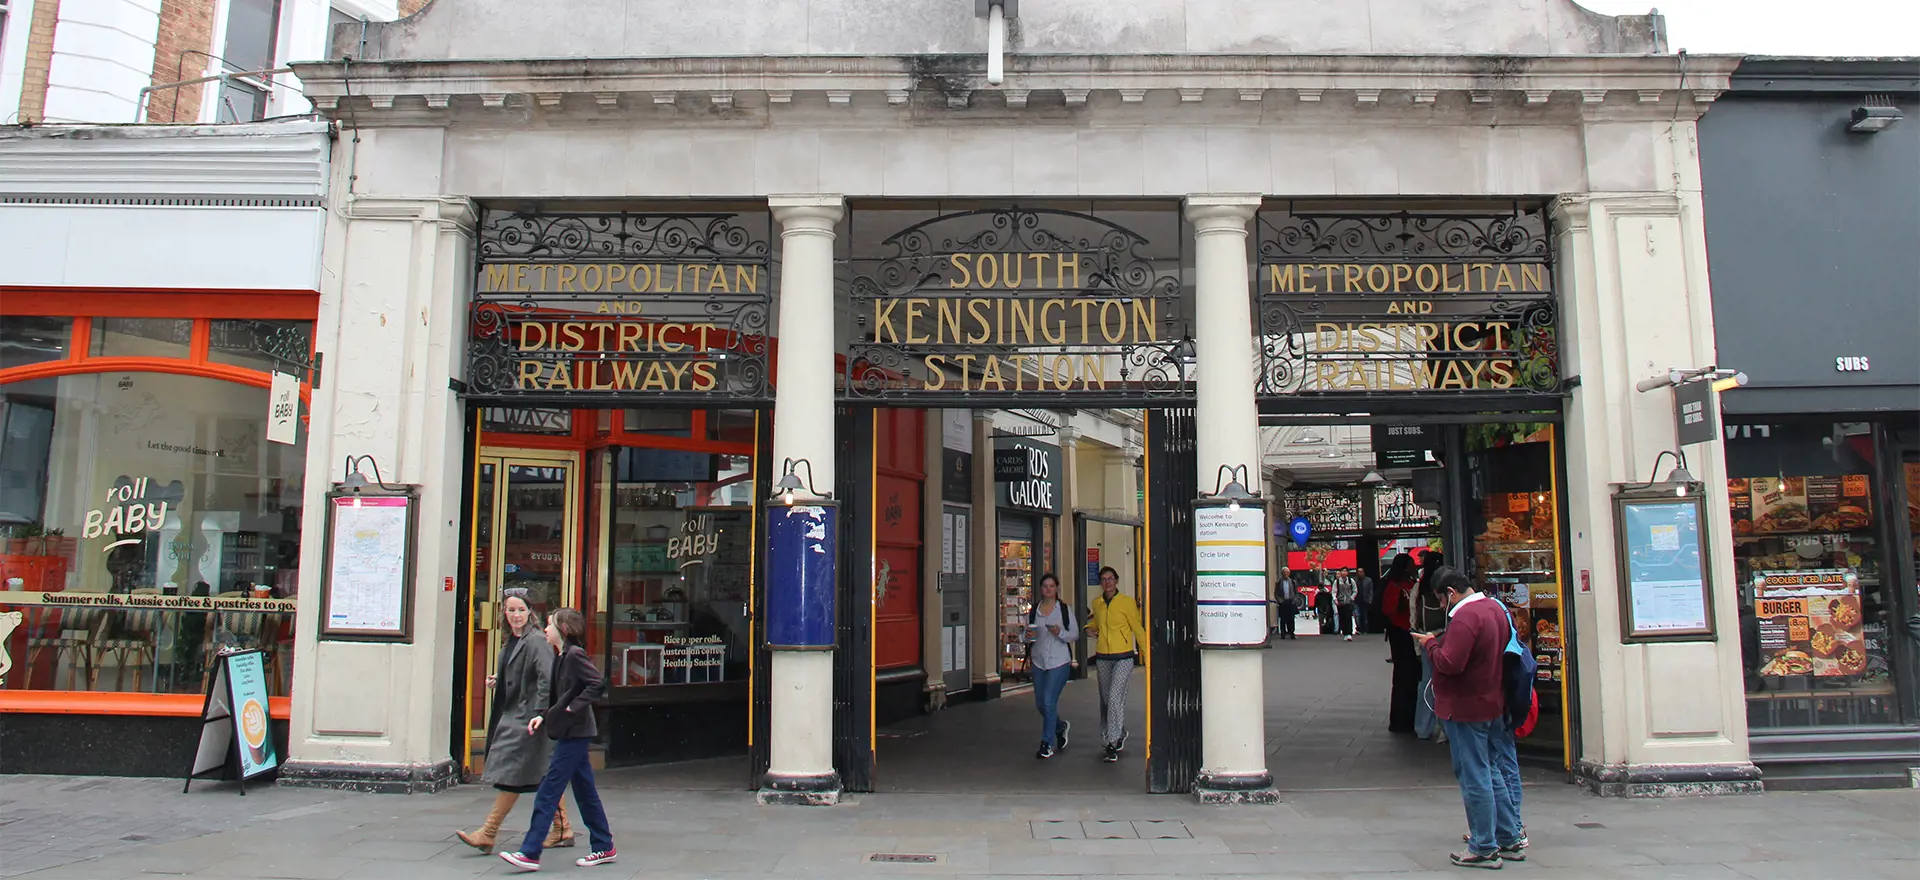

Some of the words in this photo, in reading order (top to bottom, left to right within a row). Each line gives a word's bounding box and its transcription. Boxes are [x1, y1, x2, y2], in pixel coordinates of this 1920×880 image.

[485, 263, 758, 293] METROPOLITAN
[950, 252, 1079, 289] SOUTH
[1270, 263, 1543, 293] METROPOLITAN
[596, 301, 643, 314] AND
[1386, 301, 1433, 314] AND
[874, 297, 1157, 344] KENSINGTON
[519, 322, 716, 353] DISTRICT
[1315, 322, 1510, 352] DISTRICT
[924, 354, 1105, 391] STATION
[1316, 360, 1514, 390] RAILWAYS
[1836, 356, 1869, 371] SUBS
[519, 360, 718, 391] RAILWAYS
[275, 403, 294, 419] BABY
[1388, 427, 1403, 435] JUST
[147, 440, 160, 450] Let
[160, 442, 173, 452] the
[173, 445, 192, 454] good
[996, 457, 1024, 465] CARDS
[1014, 443, 1049, 479] RDS
[106, 476, 148, 503] roll
[1009, 479, 1053, 510] GALORE
[81, 500, 168, 540] BABY
[680, 514, 706, 533] roll
[666, 533, 719, 559] BABY
[1766, 574, 1801, 585] COOLEST
[1802, 574, 1820, 584] ICED
[1822, 574, 1843, 584] LATTE
[43, 592, 92, 604] Summer
[94, 595, 123, 606] rolls,
[125, 595, 163, 606] Aussie
[164, 597, 200, 607] coffee
[202, 597, 212, 608] &
[213, 598, 261, 610] pastries
[263, 600, 276, 610] to
[277, 602, 296, 612] go.
[1763, 601, 1802, 614] BURGER
[1200, 611, 1228, 619] Piccadilly
[664, 635, 680, 644] Rice
[703, 634, 722, 643] rolls.
[663, 659, 693, 668] Healthy
